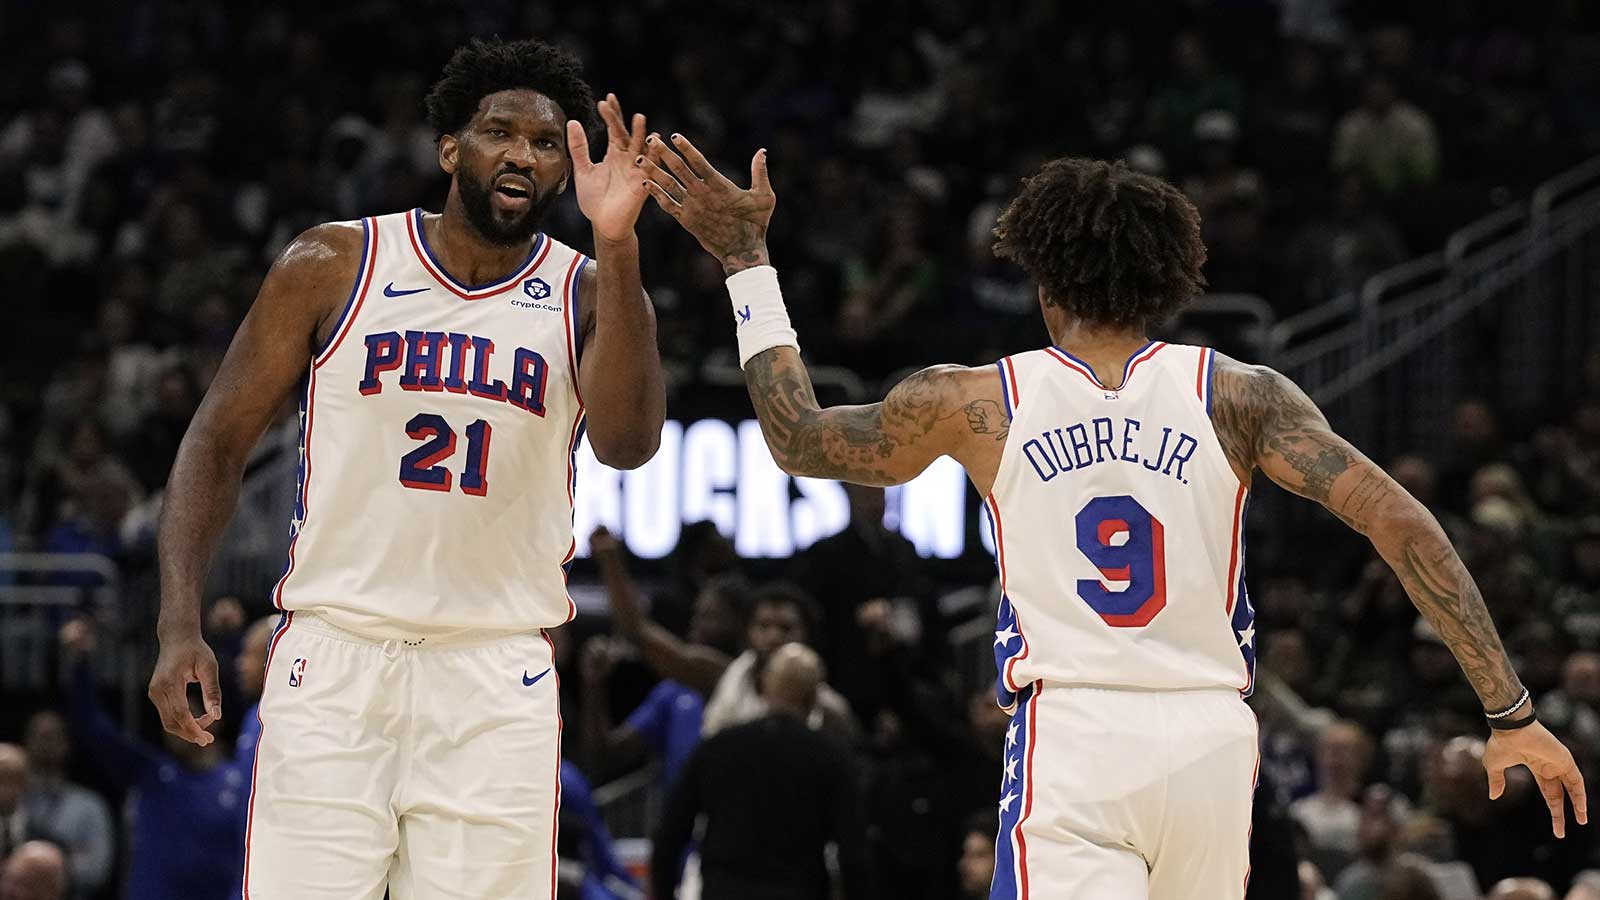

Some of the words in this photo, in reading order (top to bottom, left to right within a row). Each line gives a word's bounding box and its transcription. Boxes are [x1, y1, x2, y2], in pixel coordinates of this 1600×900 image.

[510, 298, 562, 313] crypto.com
[359, 330, 549, 418] PHILA
[399, 413, 492, 497] 21
[1022, 417, 1140, 482] OUBRE
[1143, 427, 1198, 485] JR.
[1075, 494, 1167, 628] 9
